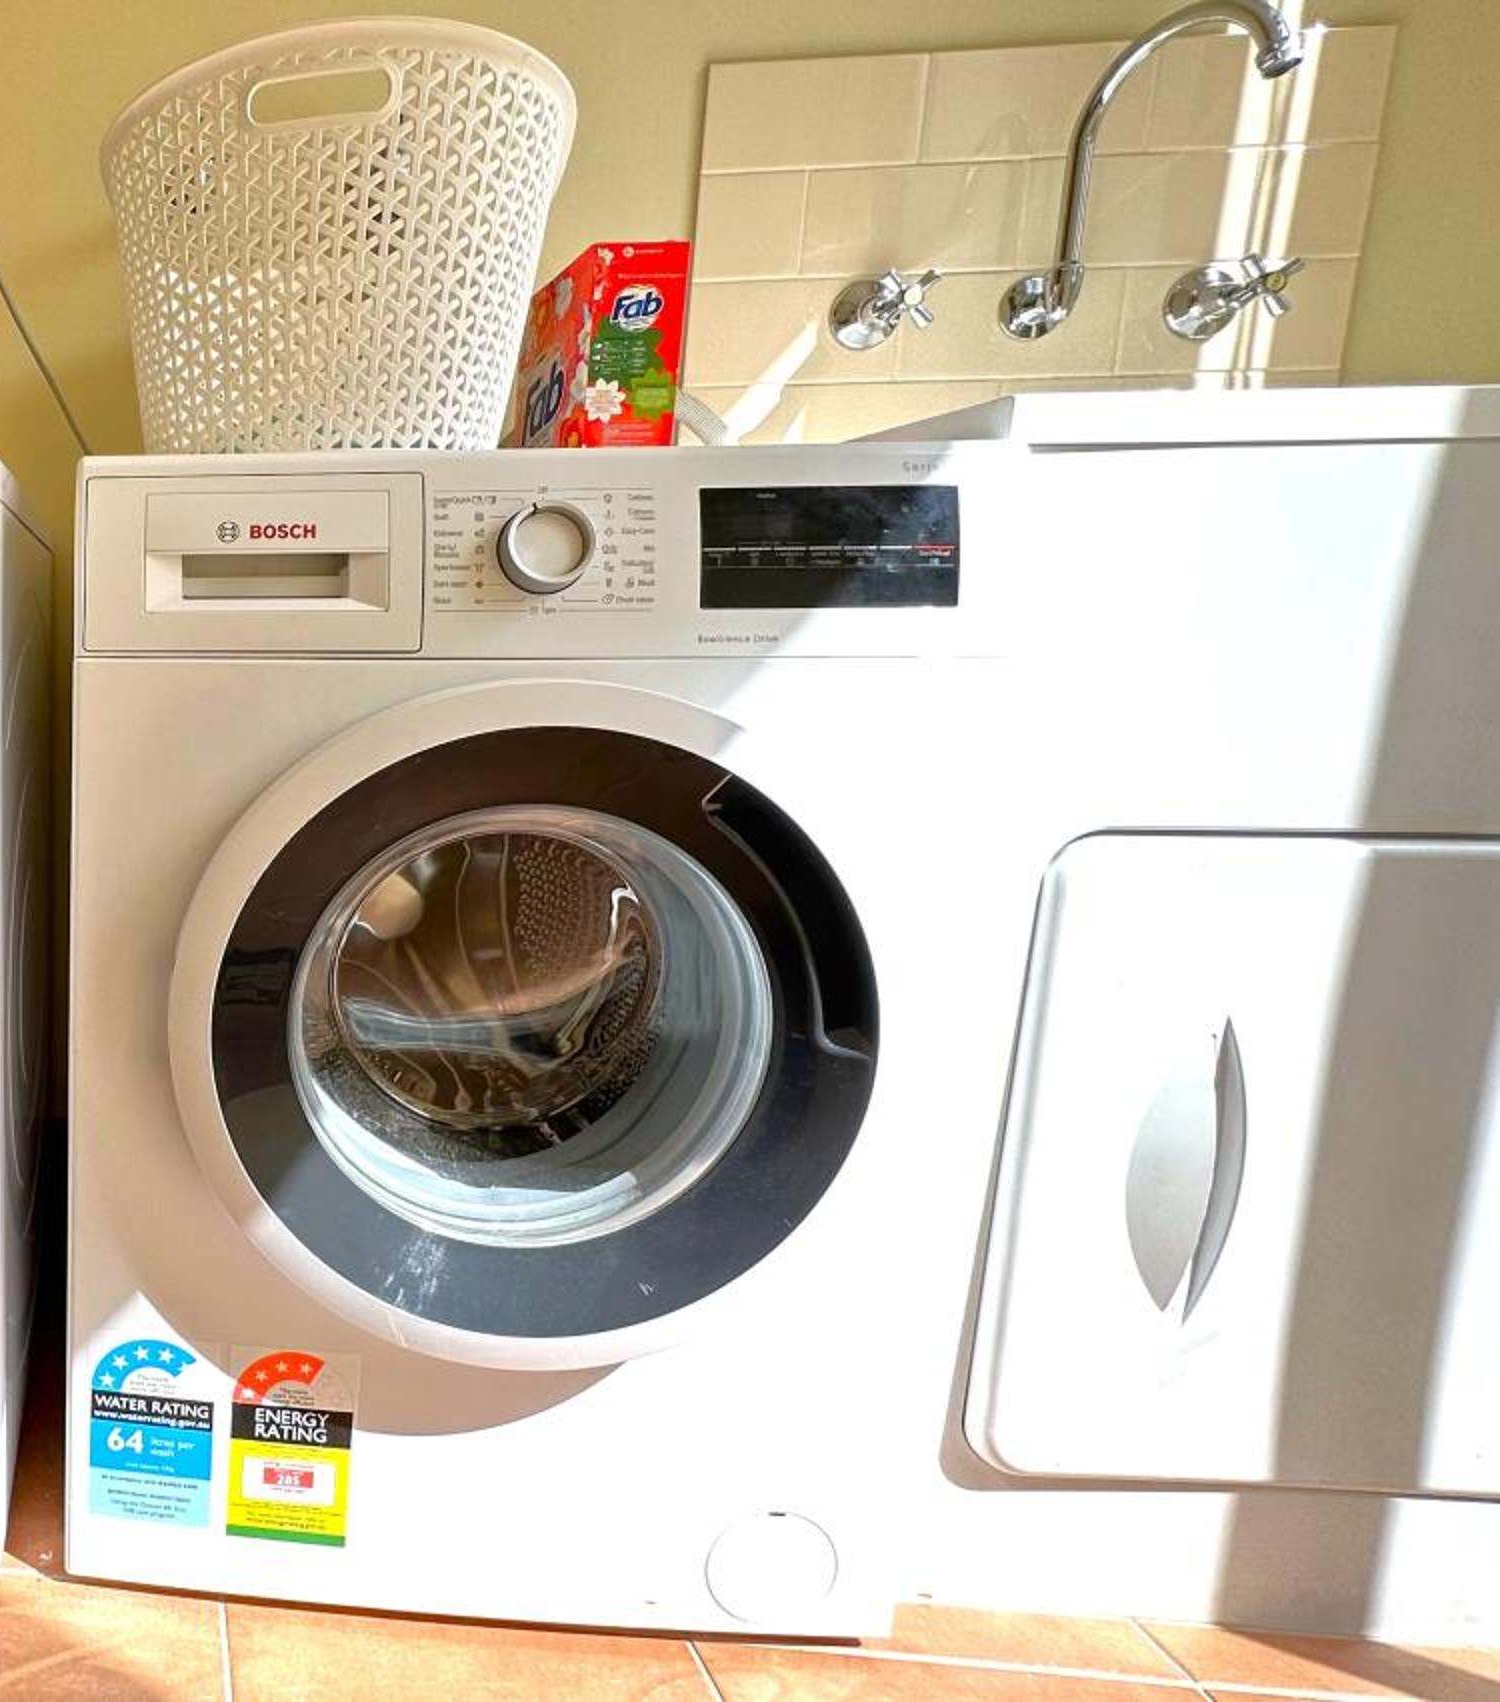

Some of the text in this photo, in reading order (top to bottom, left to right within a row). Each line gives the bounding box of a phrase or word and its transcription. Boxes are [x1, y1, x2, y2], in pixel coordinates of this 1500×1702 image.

[611, 291, 664, 321] Fab
[249, 523, 317, 540] BOSCH
[93, 1393, 210, 1420] WATER RATING
[253, 1407, 330, 1428] ENERGY
[106, 1426, 144, 1455] 64
[253, 1424, 328, 1444] RATING
